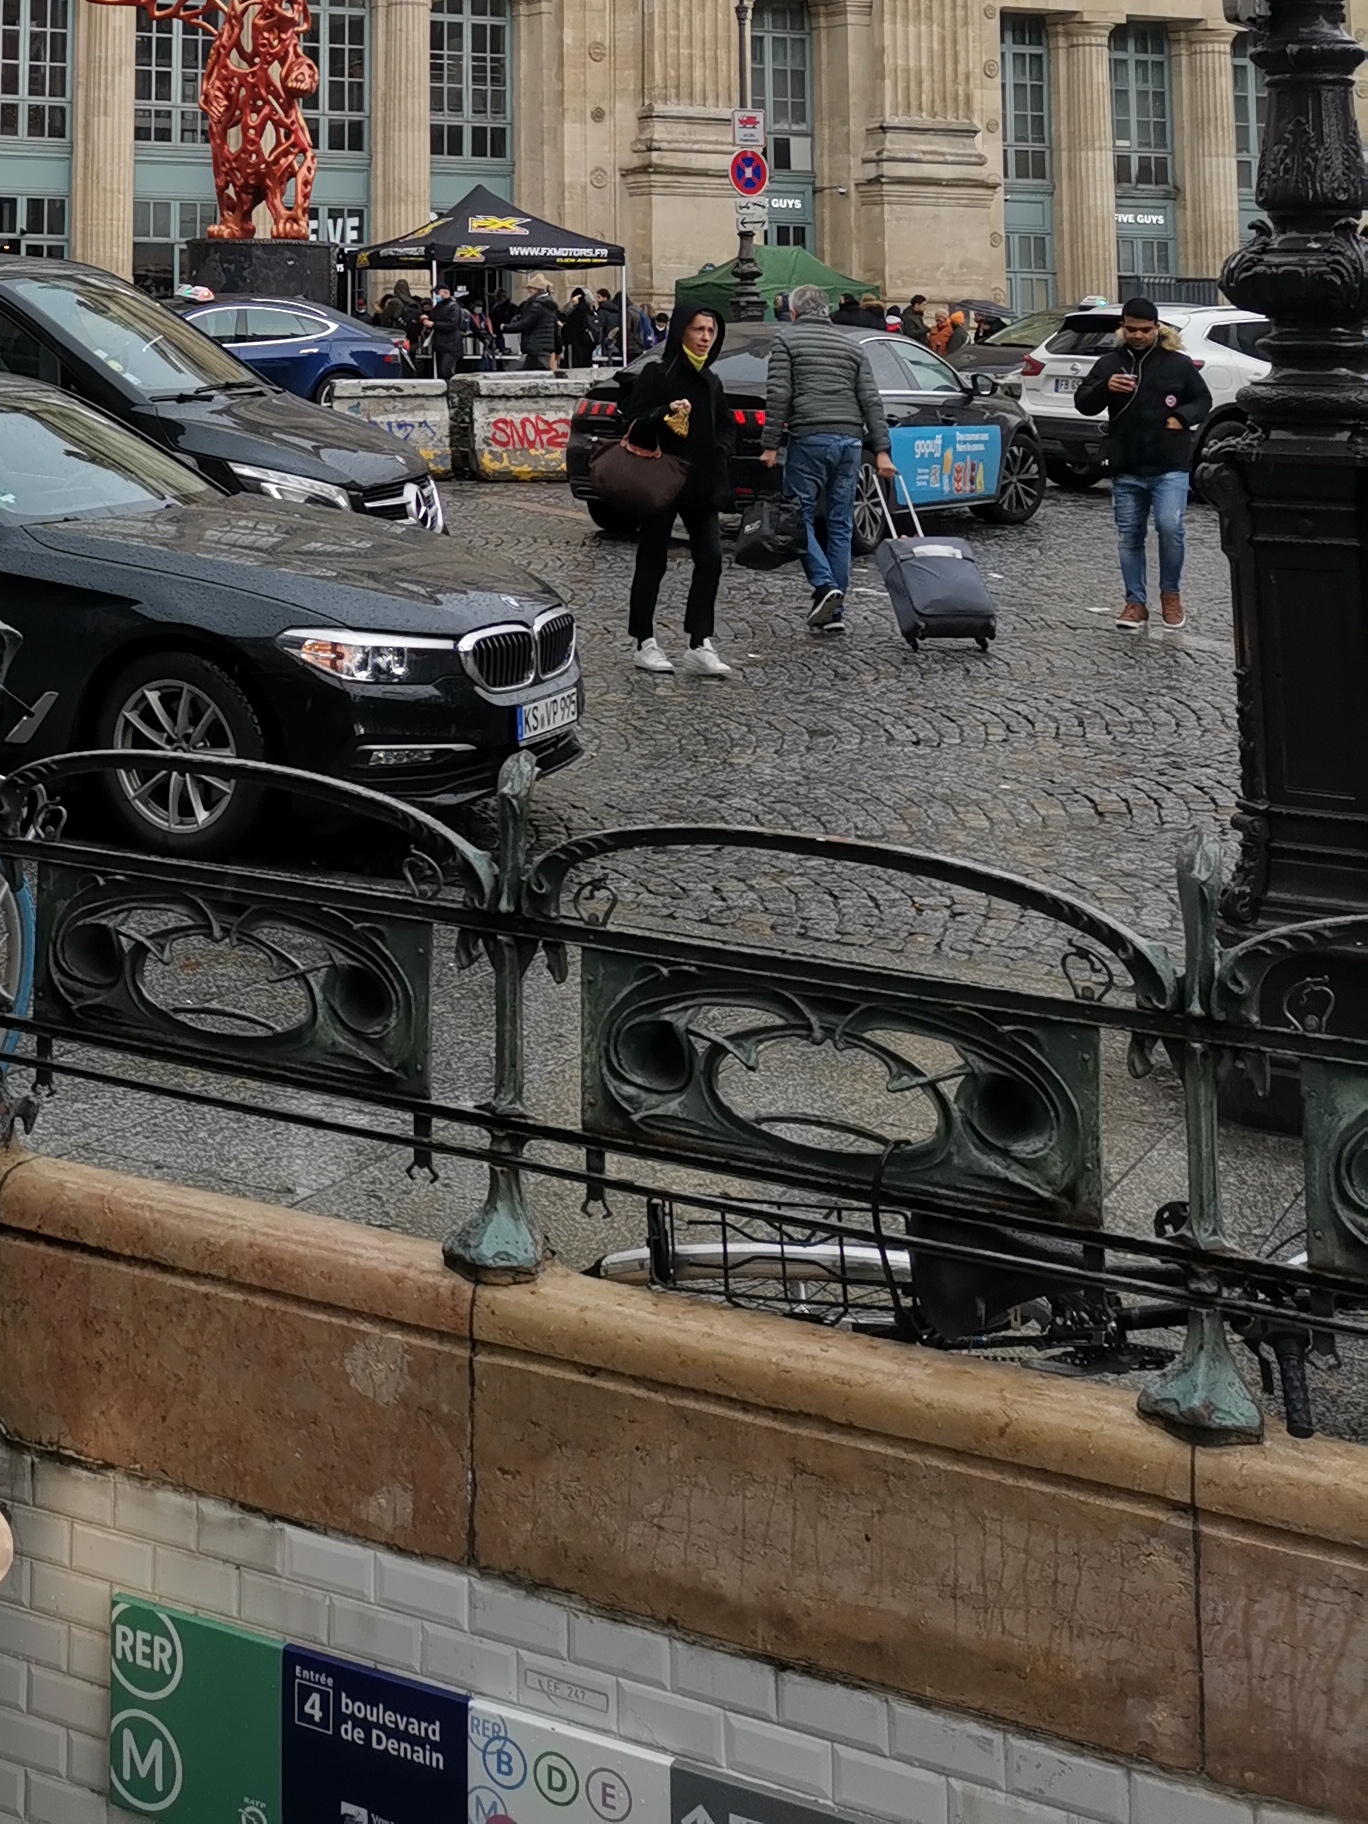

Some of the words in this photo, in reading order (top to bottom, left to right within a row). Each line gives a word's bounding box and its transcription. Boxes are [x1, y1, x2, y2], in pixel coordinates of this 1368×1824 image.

[771, 198, 802, 209] GUYS
[1136, 214, 1165, 224] GUYS
[509, 247, 608, 258] WWW.FXMOTORS.FR
[524, 705, 539, 734] KS
[116, 1624, 172, 1675] RER
[295, 1665, 334, 1686] Entrée
[304, 1692, 323, 1722] 4
[341, 1690, 440, 1742] boulevard
[470, 1714, 503, 1741] RER
[340, 1720, 365, 1745] de
[371, 1728, 444, 1770] Denain
[122, 1727, 163, 1793] M
[496, 1750, 513, 1777] B
[547, 1764, 568, 1793] D
[243, 1797, 267, 1808] RATP
[601, 1782, 617, 1811] E
